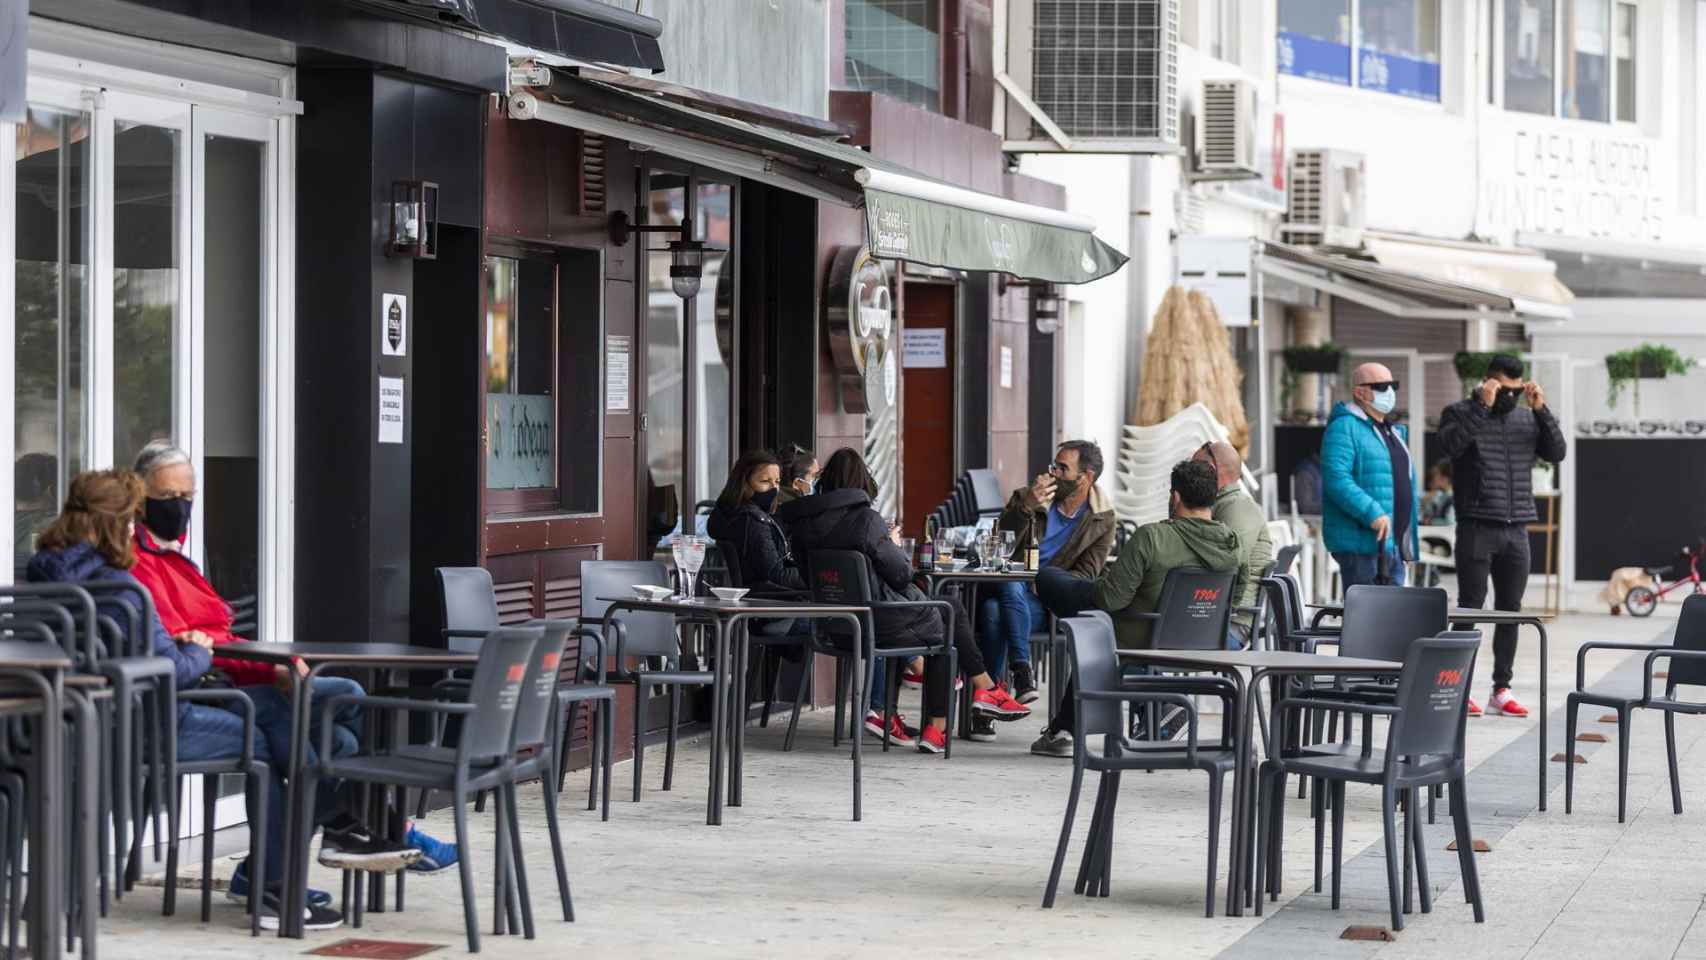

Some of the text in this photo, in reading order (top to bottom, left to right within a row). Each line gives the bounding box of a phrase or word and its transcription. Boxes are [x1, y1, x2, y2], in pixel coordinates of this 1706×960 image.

[1514, 130, 1651, 187] CASA AURORA
[1193, 588, 1218, 601] 1906
